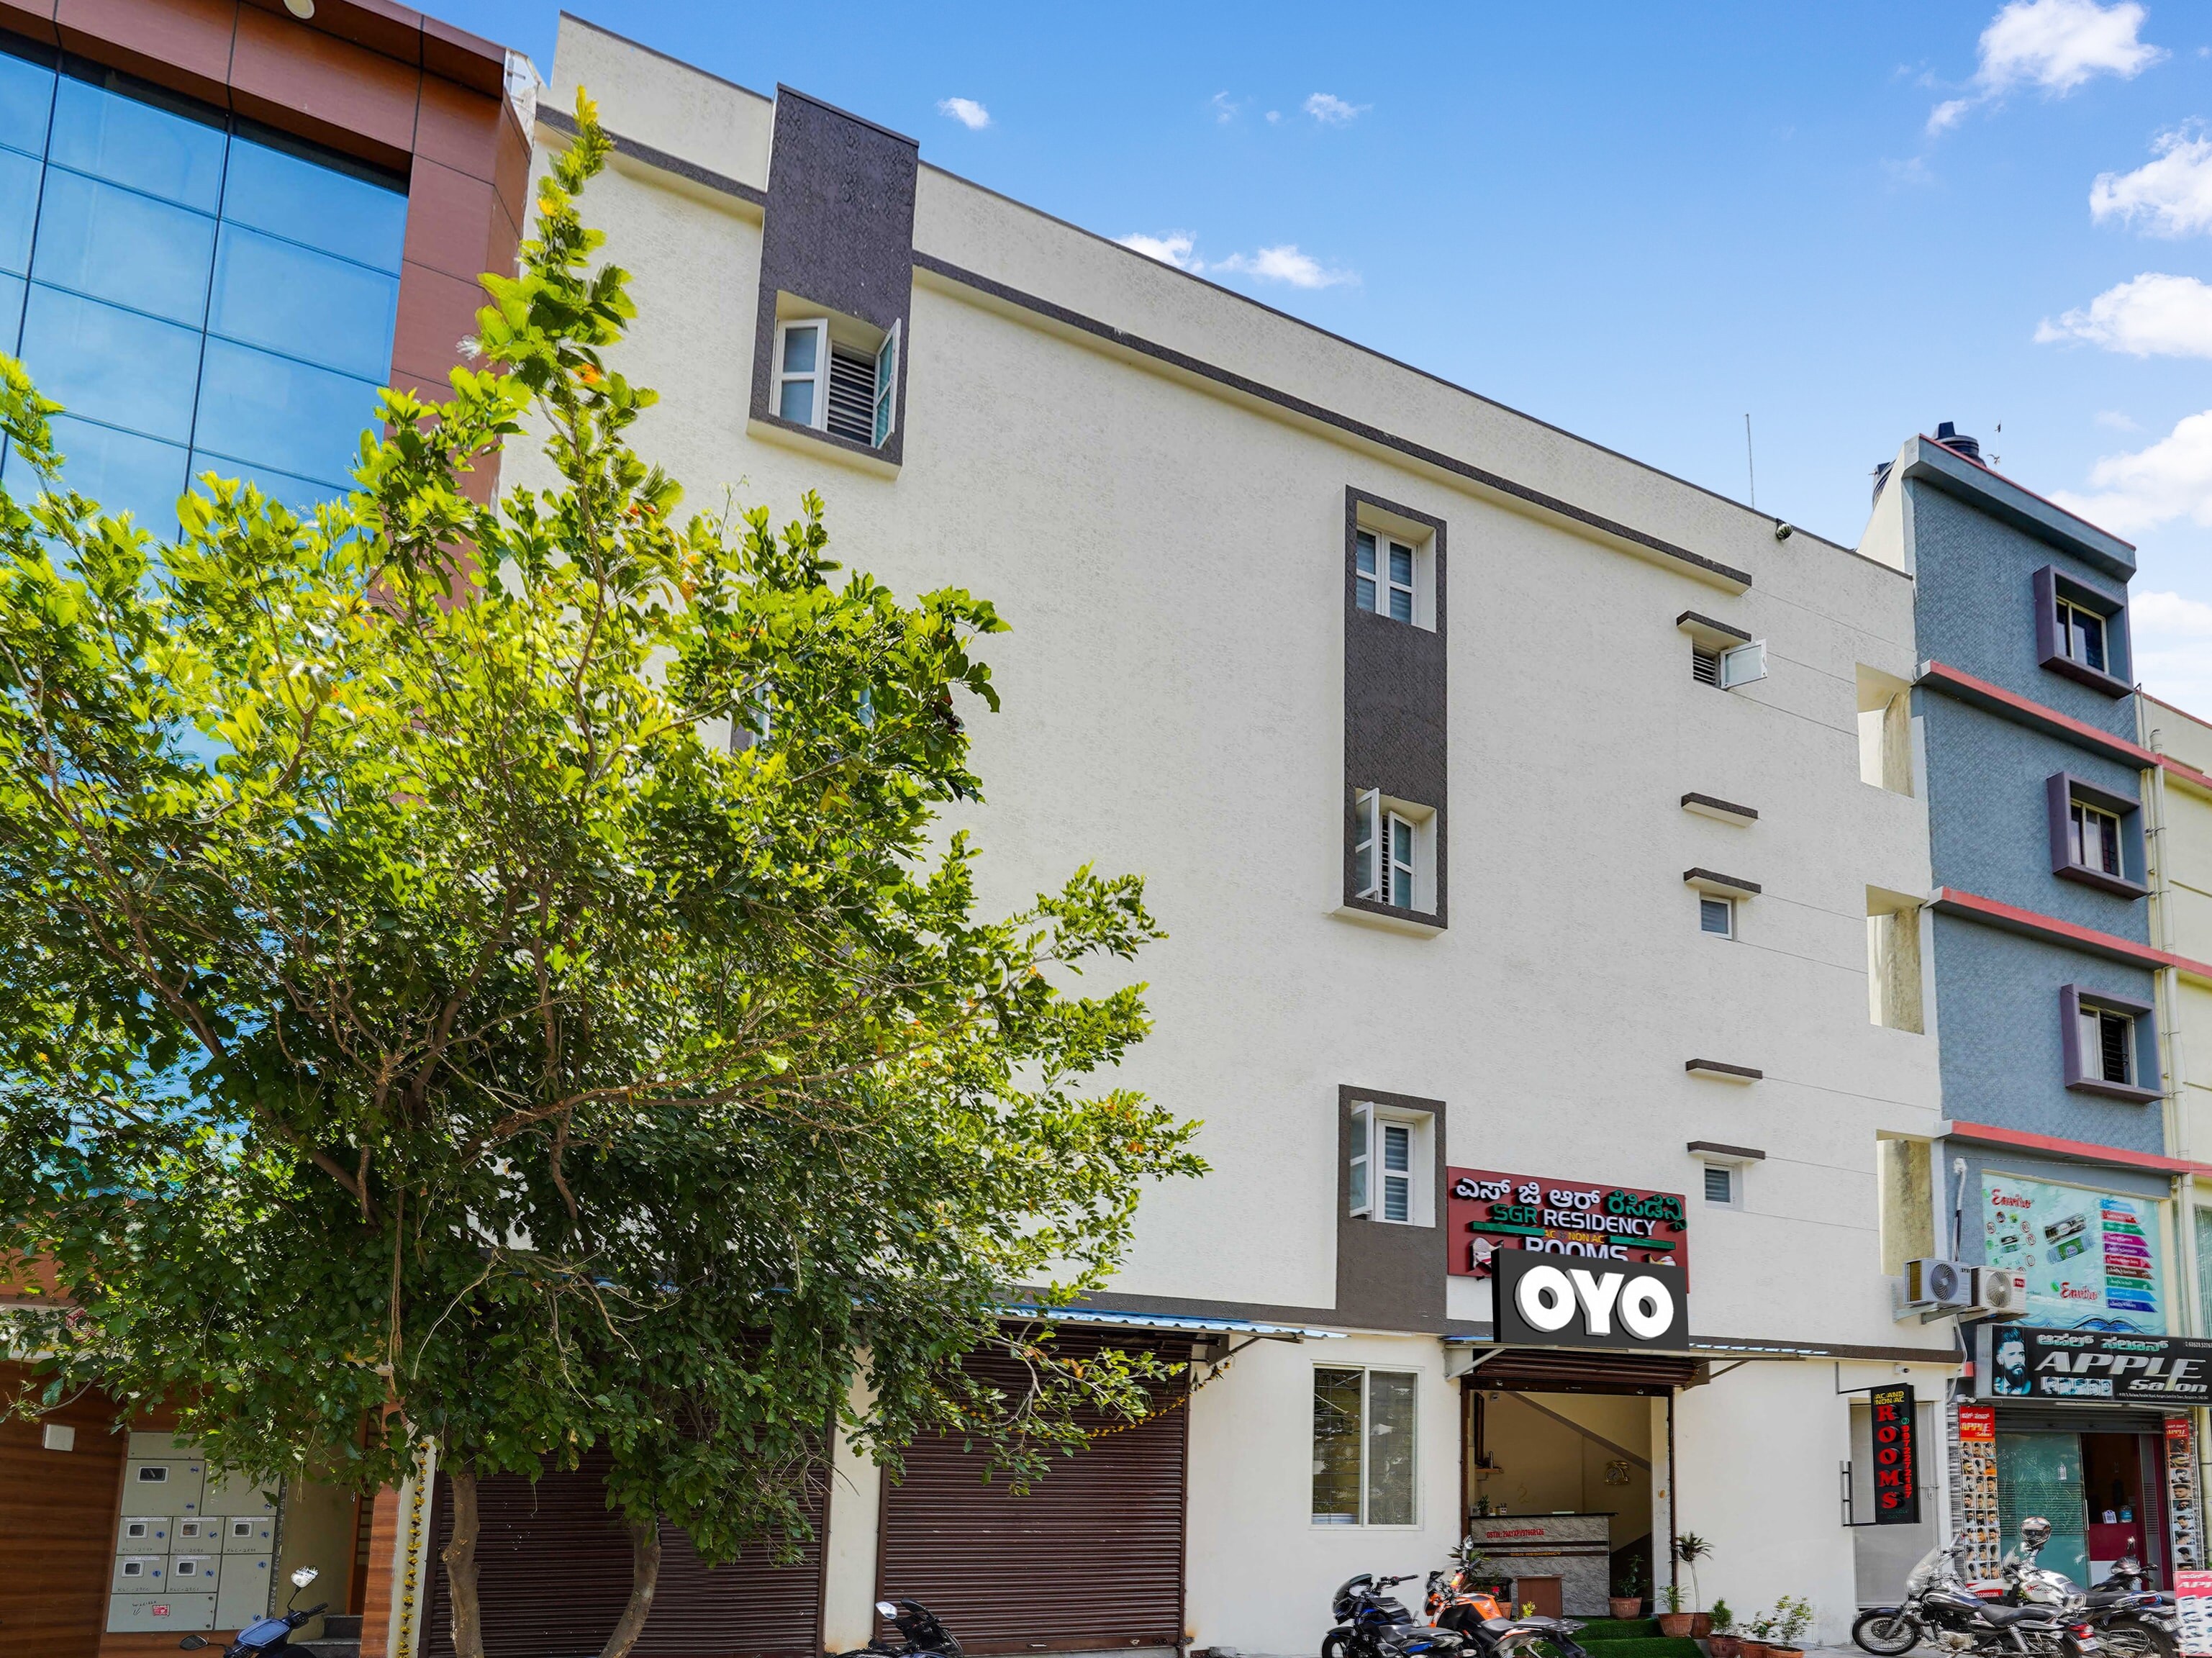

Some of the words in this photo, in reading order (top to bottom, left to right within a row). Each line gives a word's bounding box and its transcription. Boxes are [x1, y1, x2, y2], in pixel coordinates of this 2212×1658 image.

[1456, 1177, 1511, 1200] ಎಸ್
[1518, 1182, 1541, 1205] ಜಿ
[1549, 1189, 1600, 1210] ಆರ್
[1493, 1204, 1538, 1224] SGR
[1544, 1209, 1656, 1236] RESIDENCY
[1568, 1231, 1590, 1242] NON
[1591, 1234, 1605, 1244] AC
[1515, 1264, 1674, 1341] OYO
[2034, 1351, 2206, 1380] APPLE
[2127, 1379, 2208, 1392] Salon
[1961, 1422, 1991, 1432] APPLE
[1877, 1405, 1900, 1509] ROOMS
